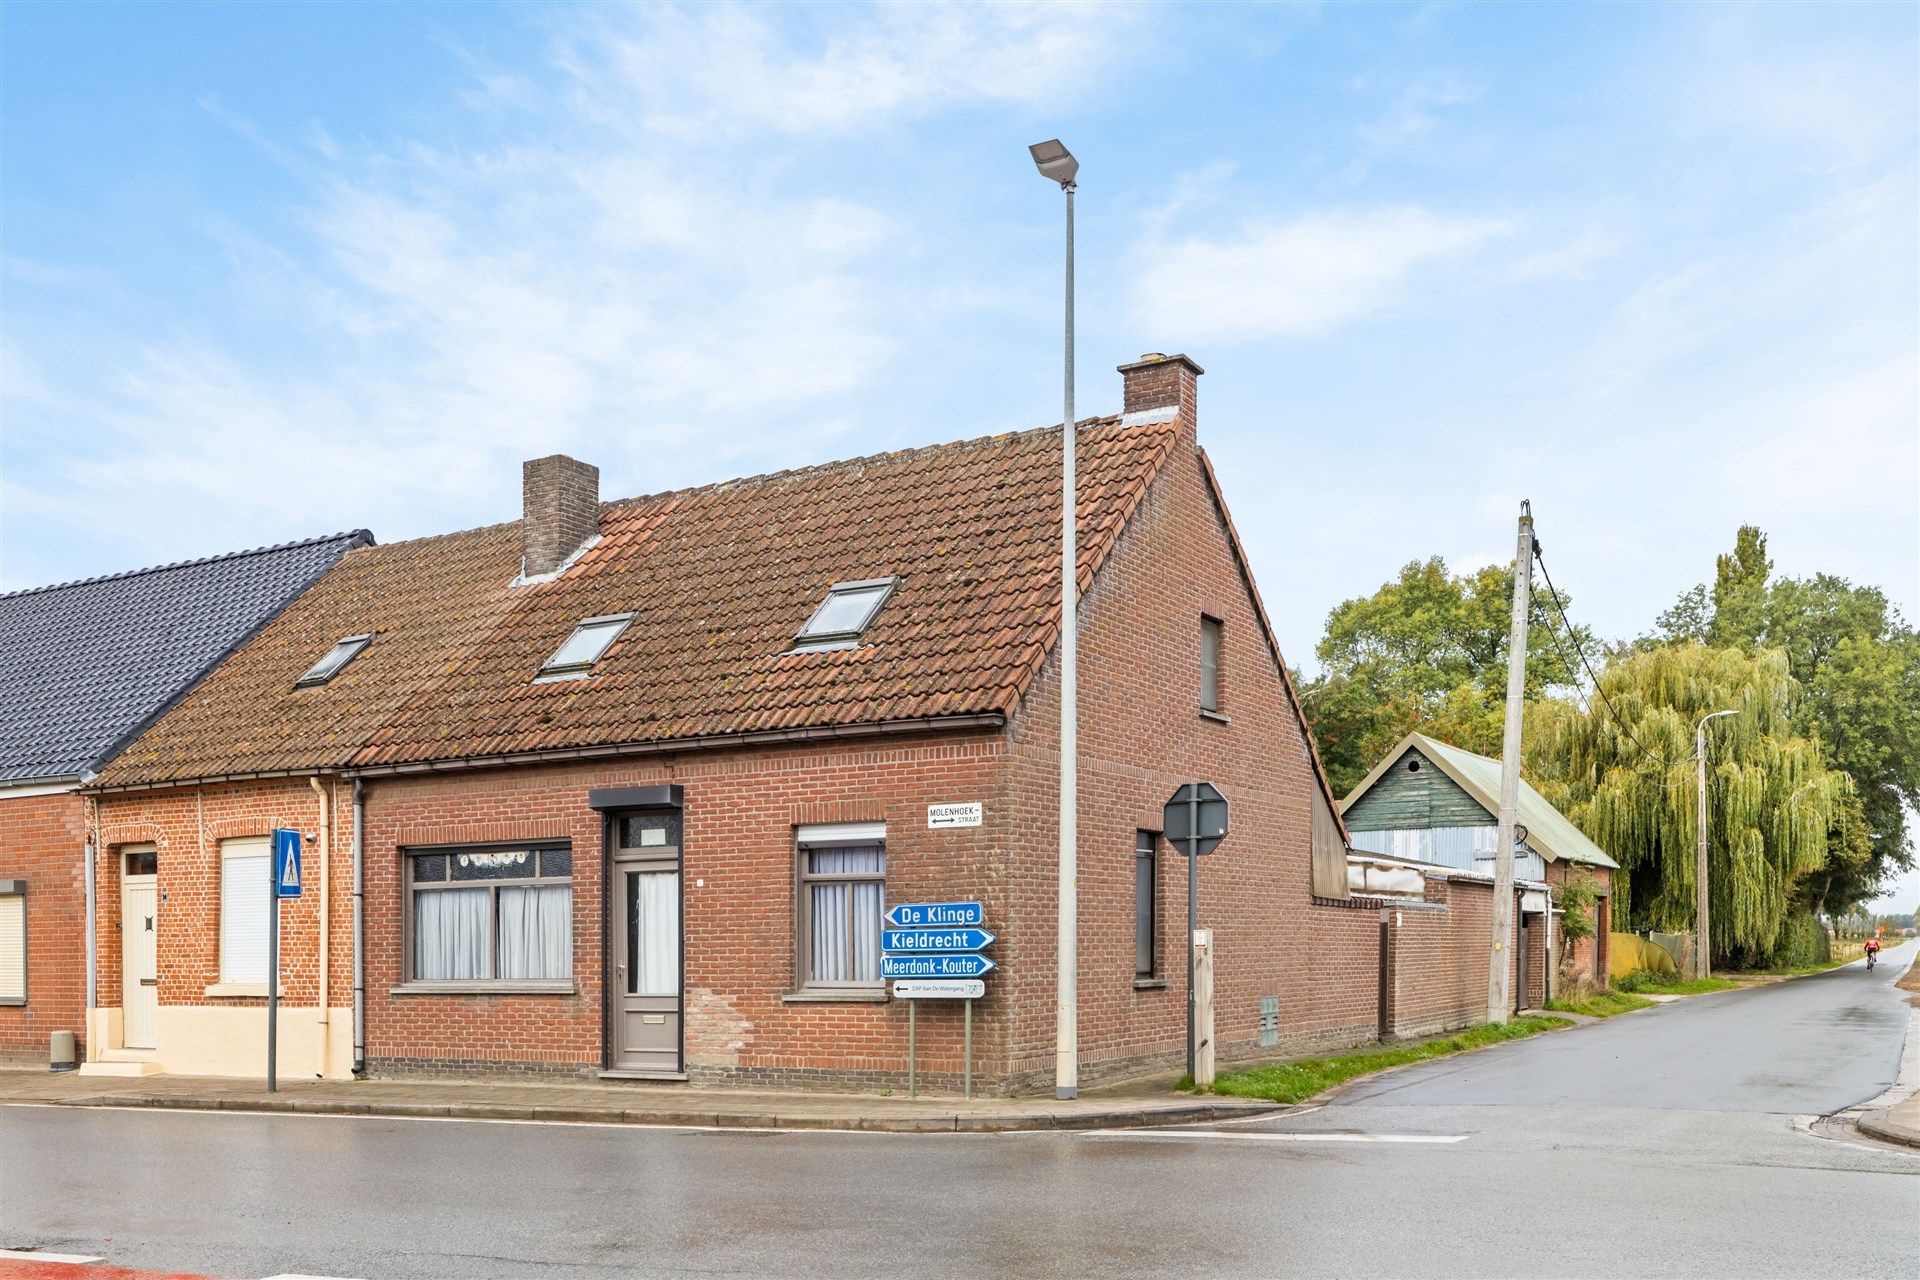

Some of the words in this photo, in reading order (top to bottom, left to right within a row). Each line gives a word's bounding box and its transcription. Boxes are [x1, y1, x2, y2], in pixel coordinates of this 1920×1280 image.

[929, 807, 980, 817] MOLENHOEK-
[902, 907, 921, 923] De
[927, 907, 974, 925] Klinge
[892, 932, 968, 948] Kieldrecht
[884, 958, 977, 974] Meerdonk-Kouter
